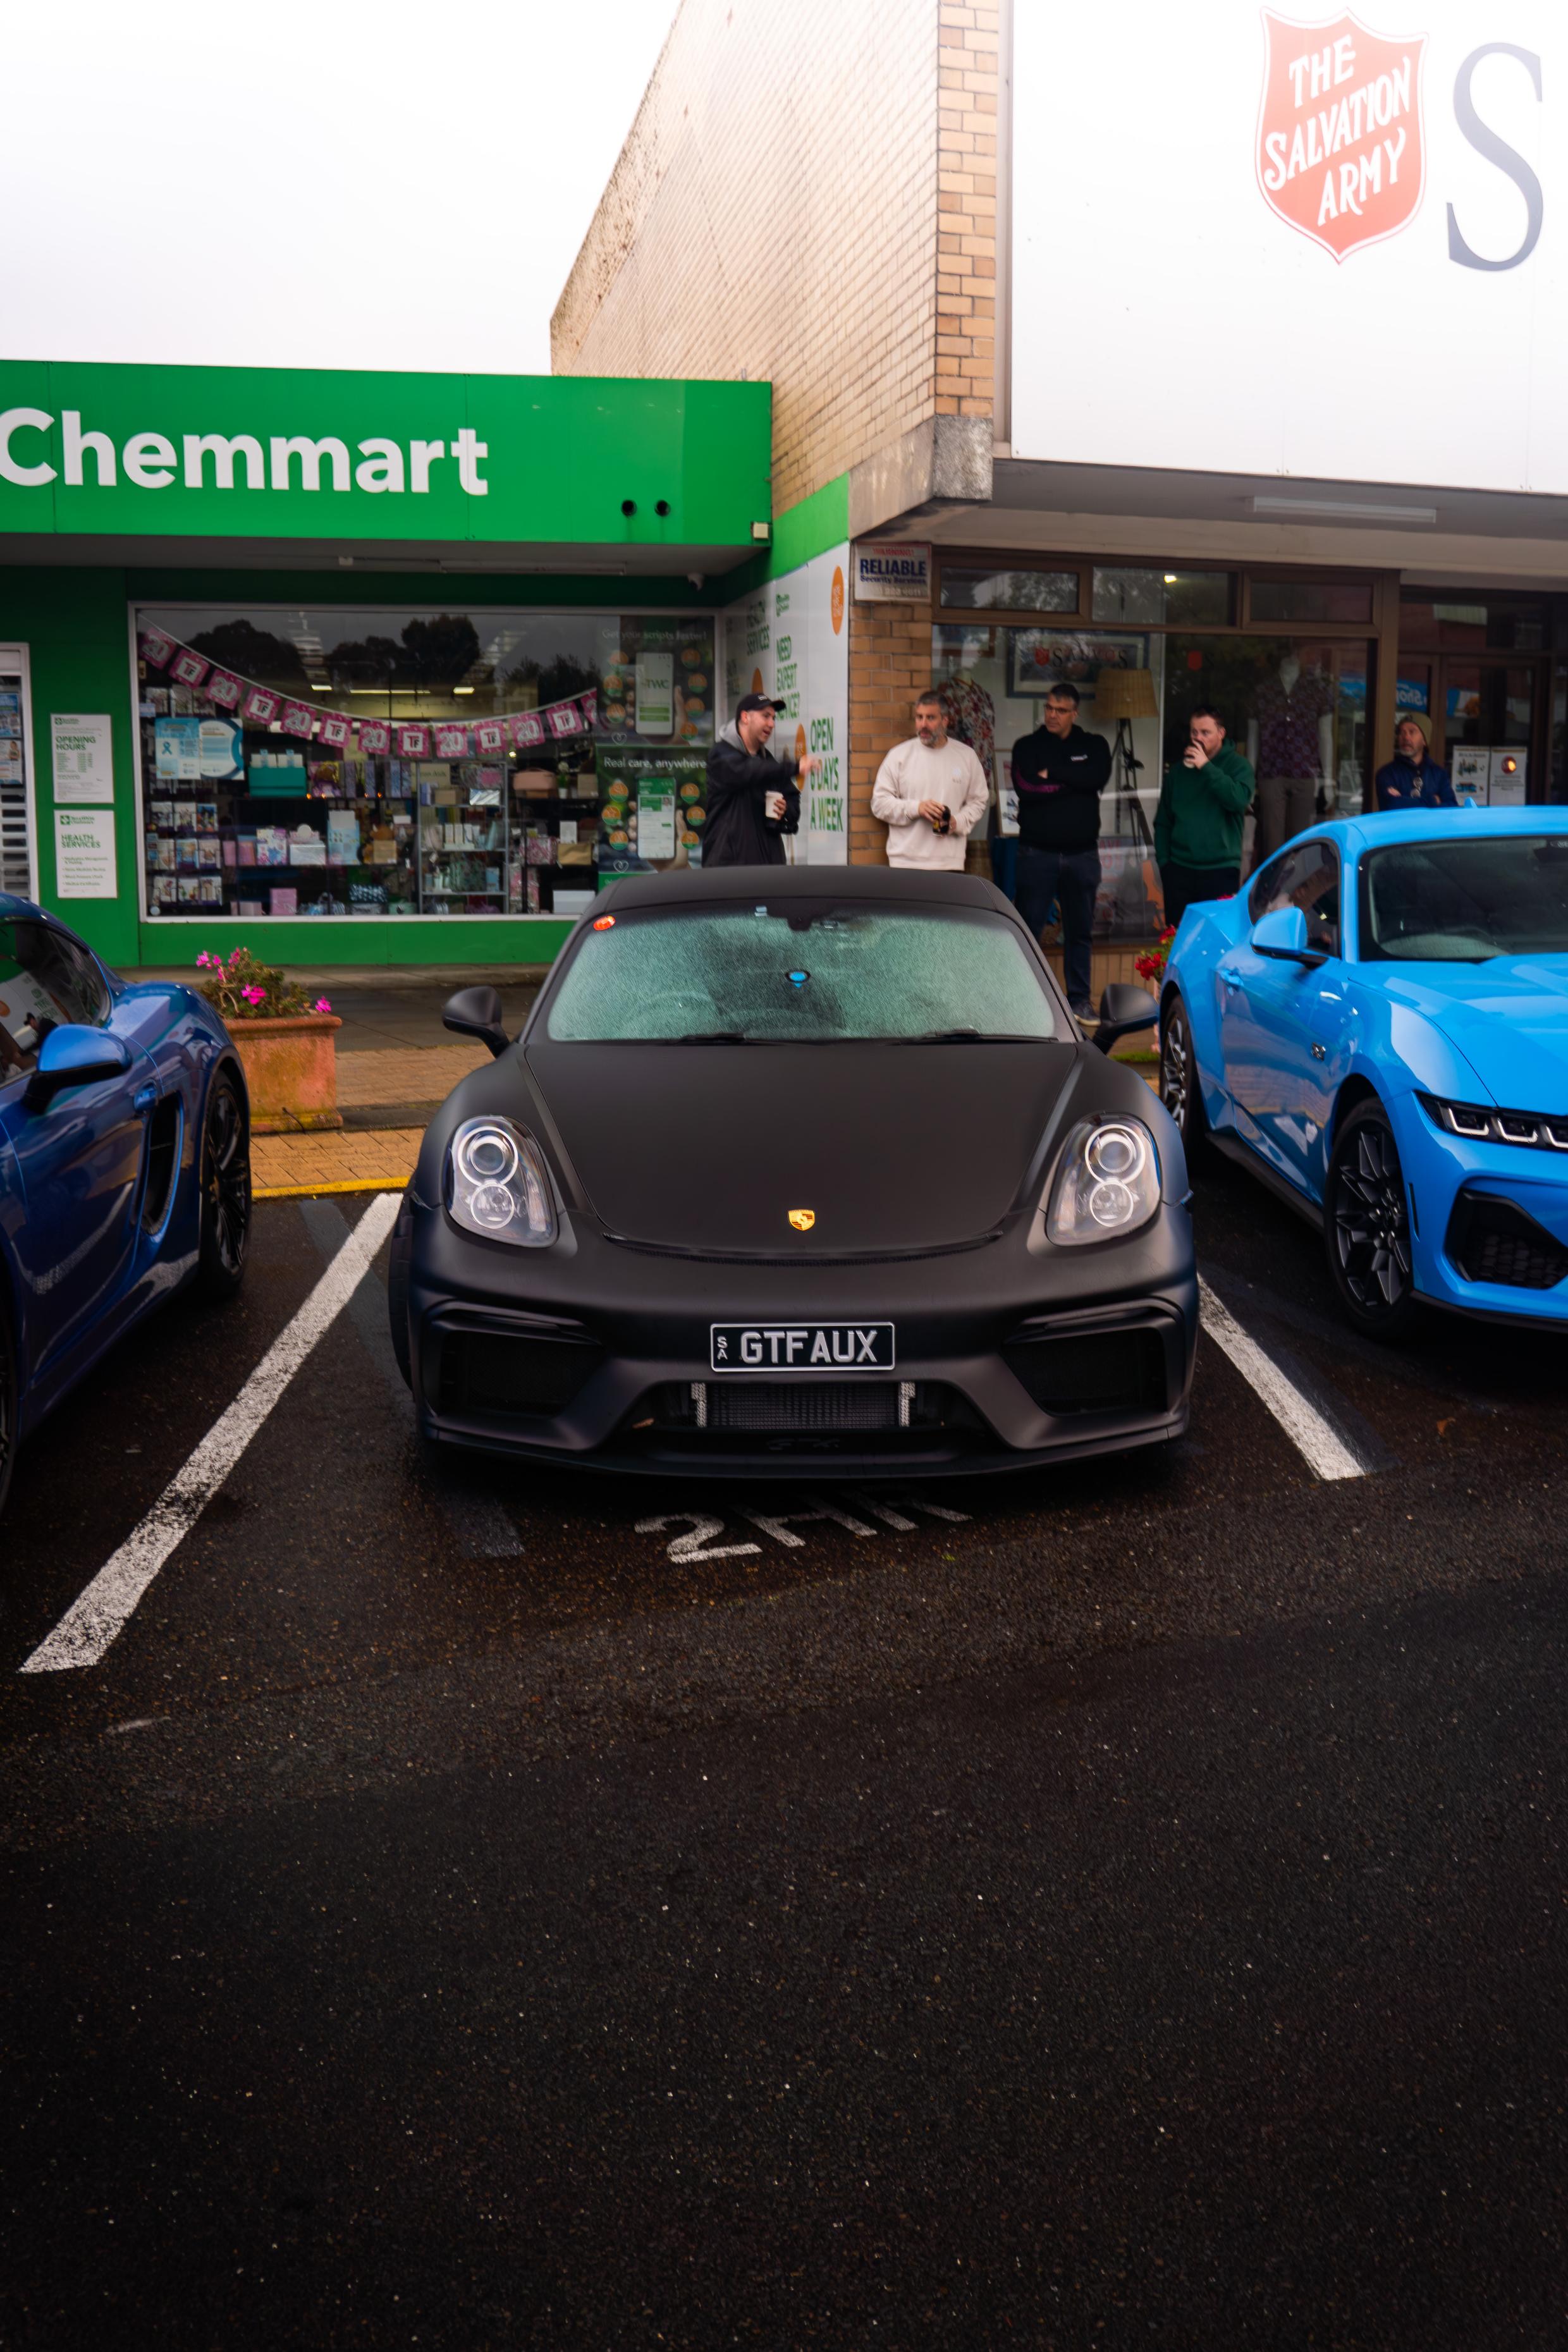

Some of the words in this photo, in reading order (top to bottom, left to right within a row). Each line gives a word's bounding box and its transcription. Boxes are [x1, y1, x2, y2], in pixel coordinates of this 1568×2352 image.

[1288, 34, 1356, 109] THE
[1264, 56, 1410, 191] SALVATION
[1317, 126, 1407, 227] ARMY
[0, 408, 489, 496] Chemmart
[860, 559, 926, 577] RELIABLE
[860, 575, 891, 584] Security
[776, 635, 792, 663] NEED
[141, 634, 169, 661] 20
[210, 677, 238, 702] 20
[286, 708, 312, 731] 20
[362, 727, 387, 749] 20
[439, 732, 463, 752] 20
[515, 720, 539, 742] 20
[776, 663, 797, 692] EXPERT
[811, 716, 834, 753] OPEN
[604, 756, 627, 768] Real
[627, 758, 653, 769] care,
[655, 756, 707, 771] anywhere
[811, 797, 816, 830] A
[818, 797, 843, 832] WEEK
[740, 1330, 878, 1364] GTFAUX
